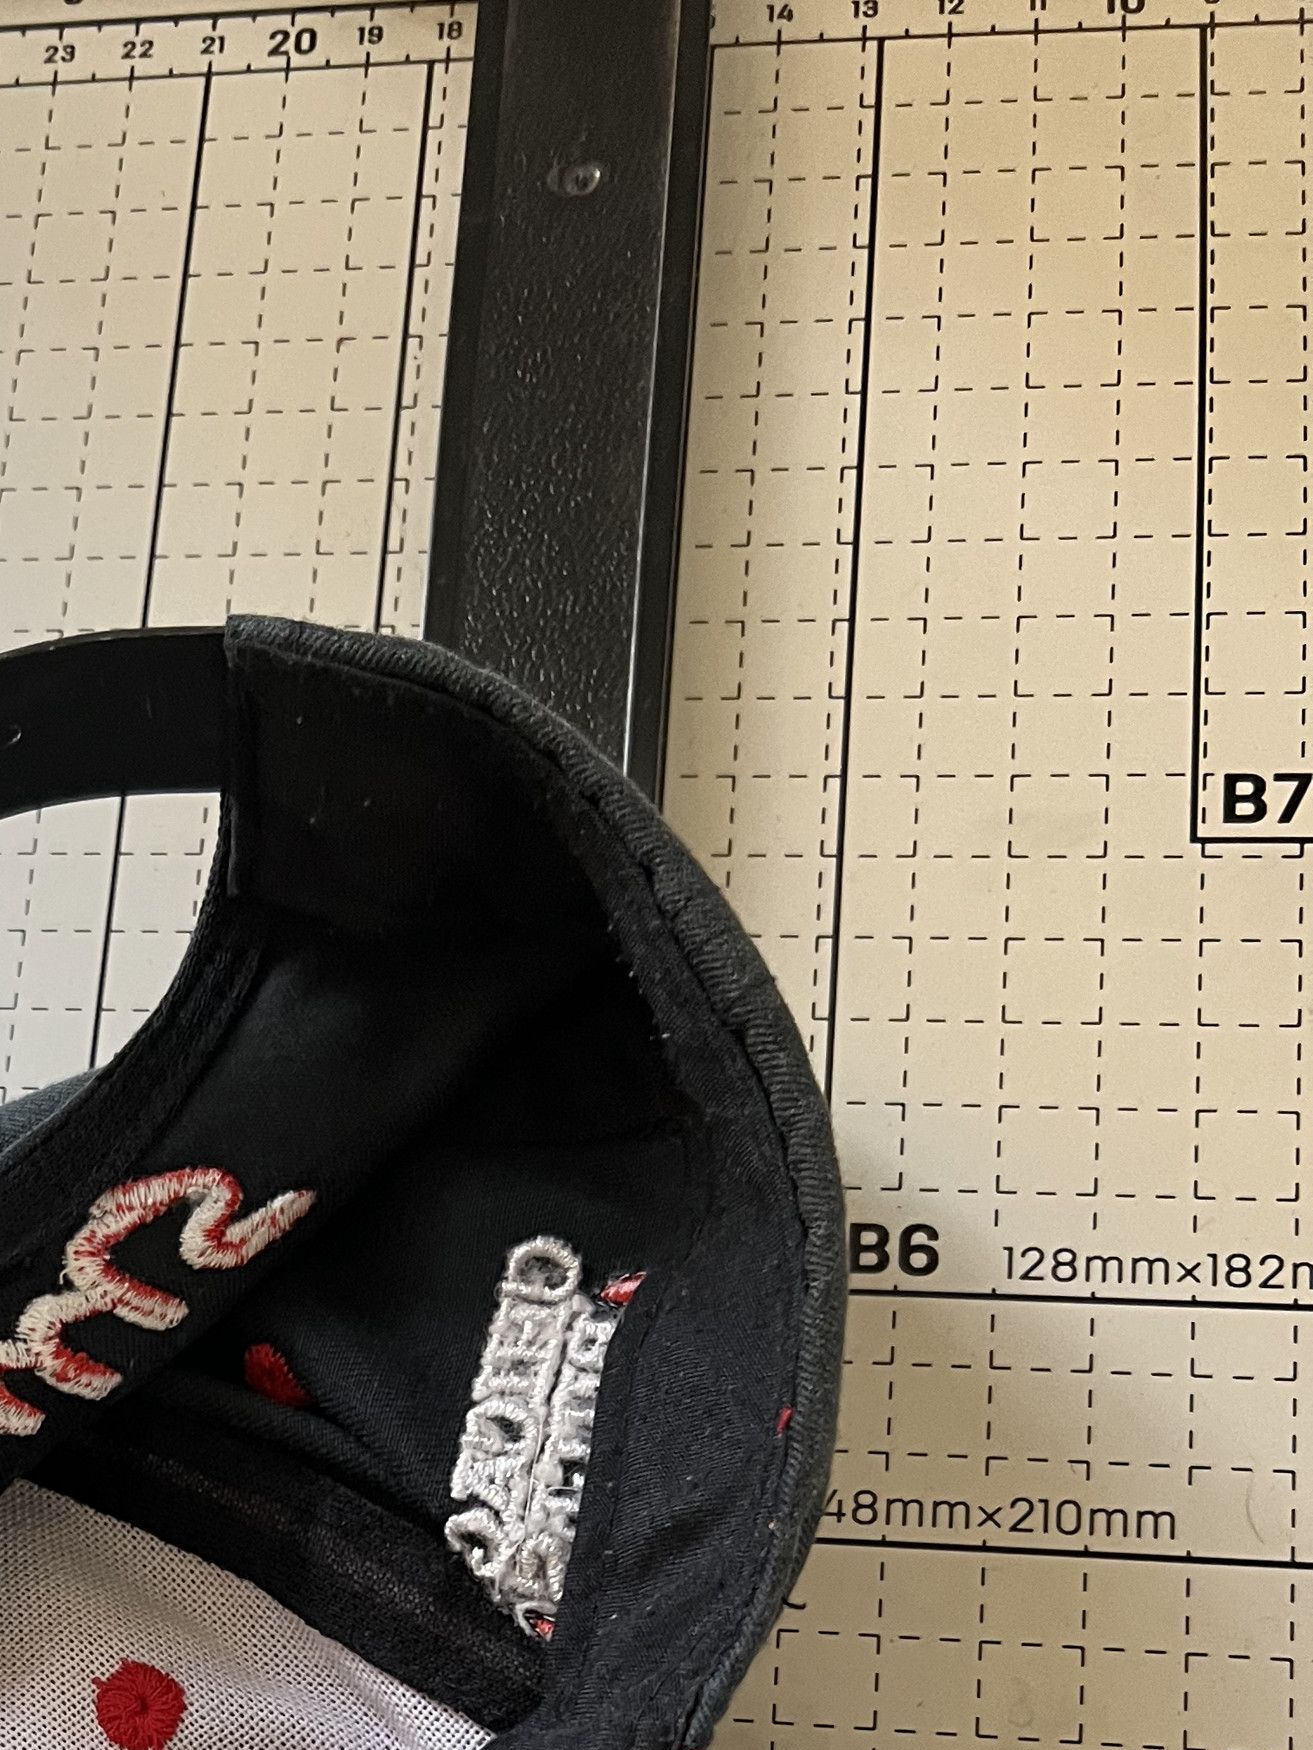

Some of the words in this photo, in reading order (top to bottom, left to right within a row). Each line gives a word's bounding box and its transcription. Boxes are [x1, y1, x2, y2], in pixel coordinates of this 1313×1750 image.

[766, 4, 794, 23] 14
[851, 0, 879, 18] 13
[43, 44, 76, 64] 23
[121, 39, 154, 60] 22
[200, 35, 226, 56] 21
[267, 27, 318, 57] 20
[357, 25, 385, 46] 19
[437, 20, 463, 41] 18
[1222, 772, 1313, 824] B7
[849, 1222, 940, 1277] B6
